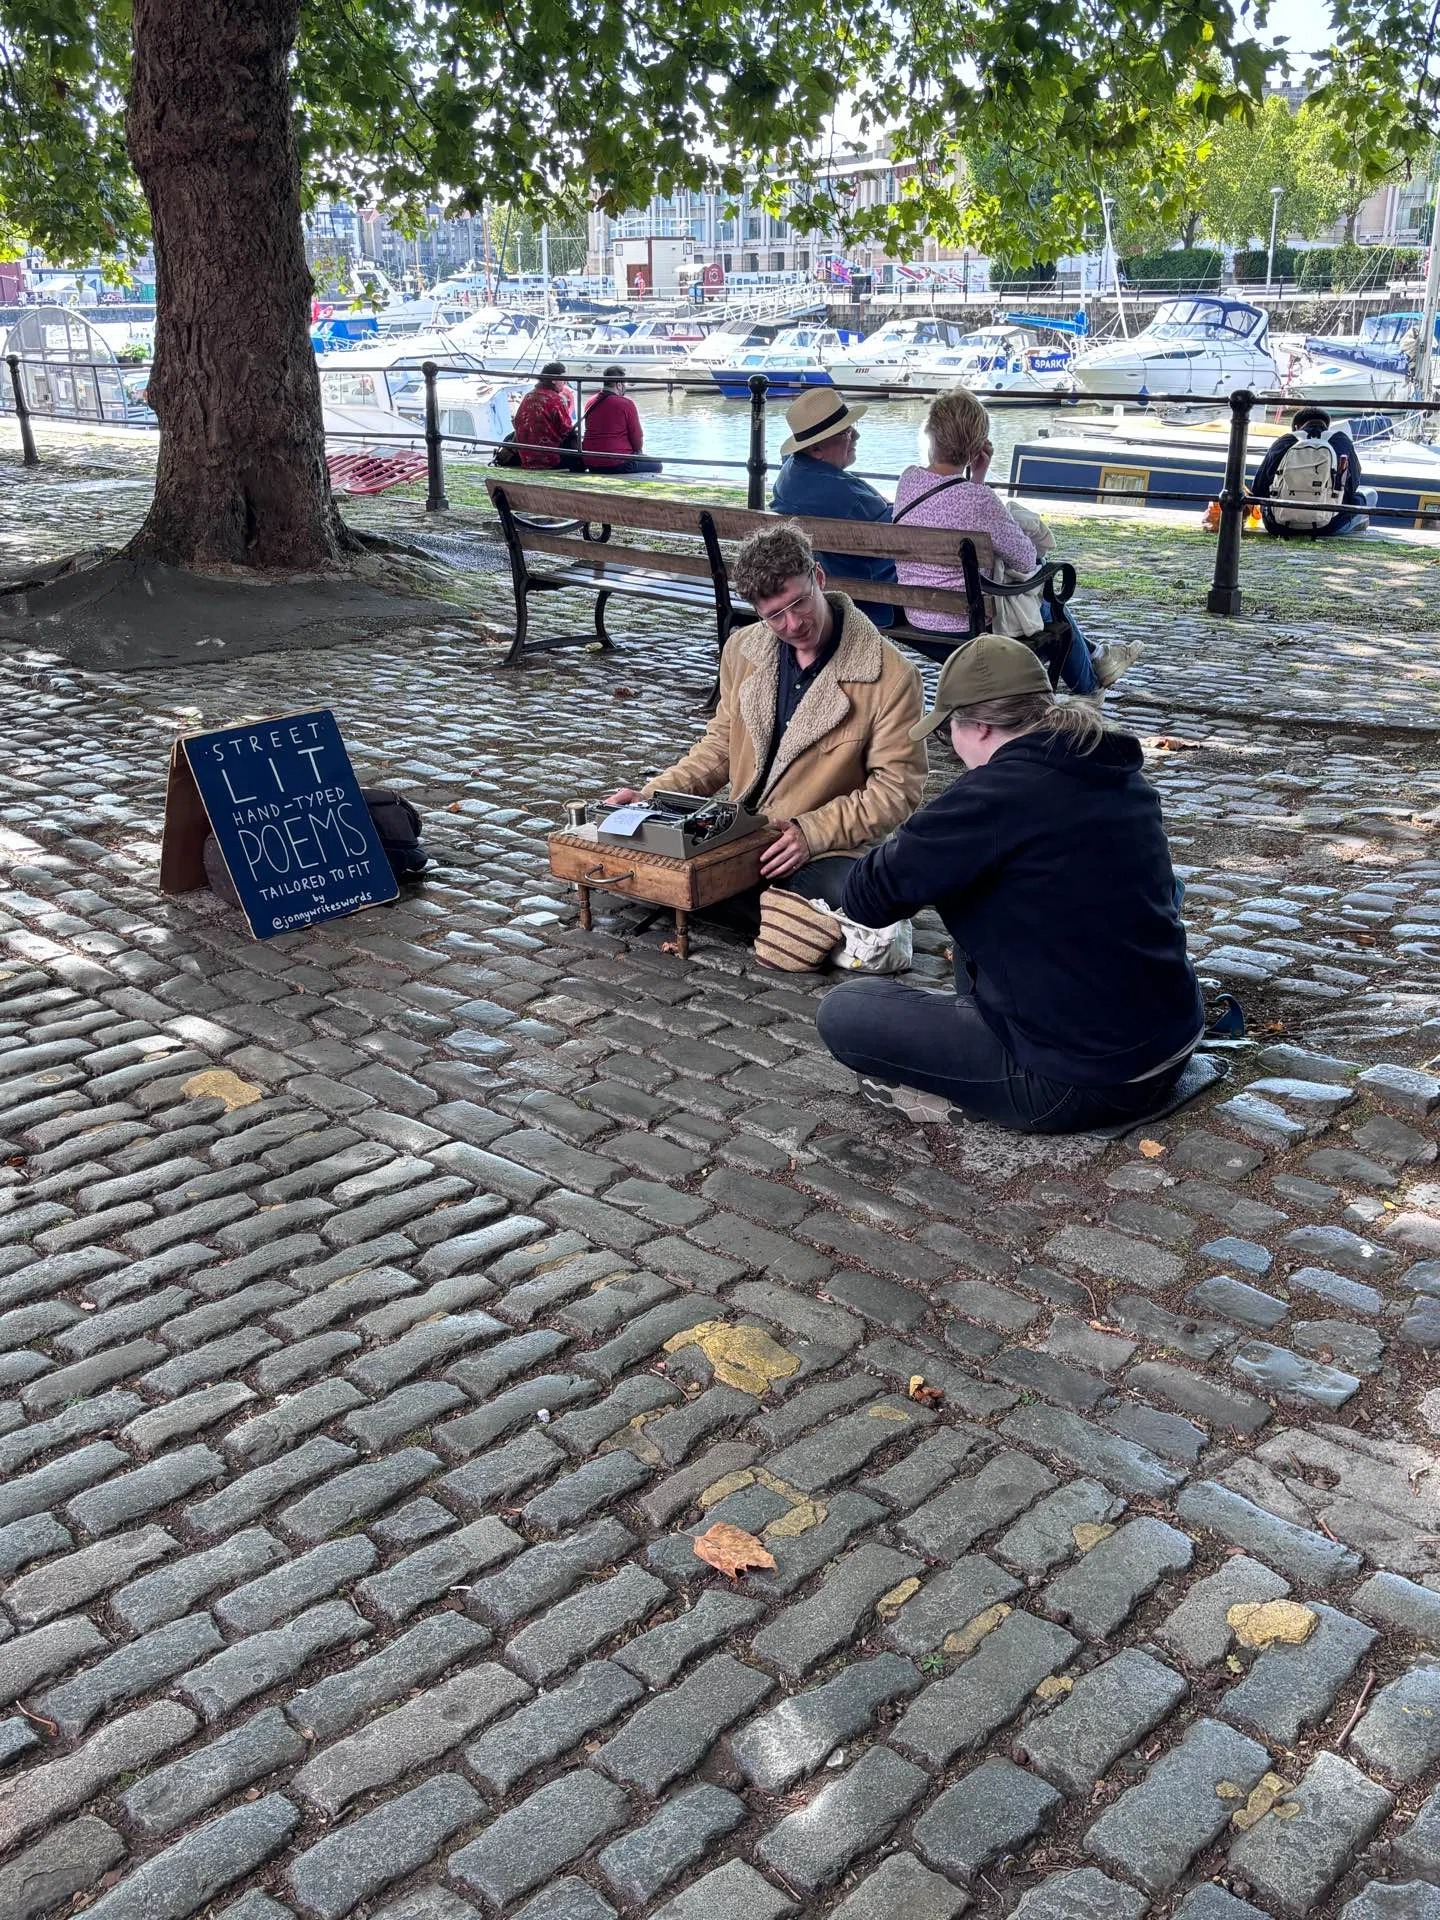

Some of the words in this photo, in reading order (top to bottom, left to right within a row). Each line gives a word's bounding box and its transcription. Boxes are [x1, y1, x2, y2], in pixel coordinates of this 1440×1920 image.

[213, 722, 319, 762] STREET
[222, 746, 324, 803] LIT
[233, 786, 345, 826] HAND-TYPED
[238, 802, 367, 881] POEMS
[259, 875, 326, 901] TAILORED
[330, 868, 345, 882] TO
[348, 861, 370, 879] FIT
[312, 893, 325, 903] by
[272, 891, 372, 930] @jonnywriteswords
